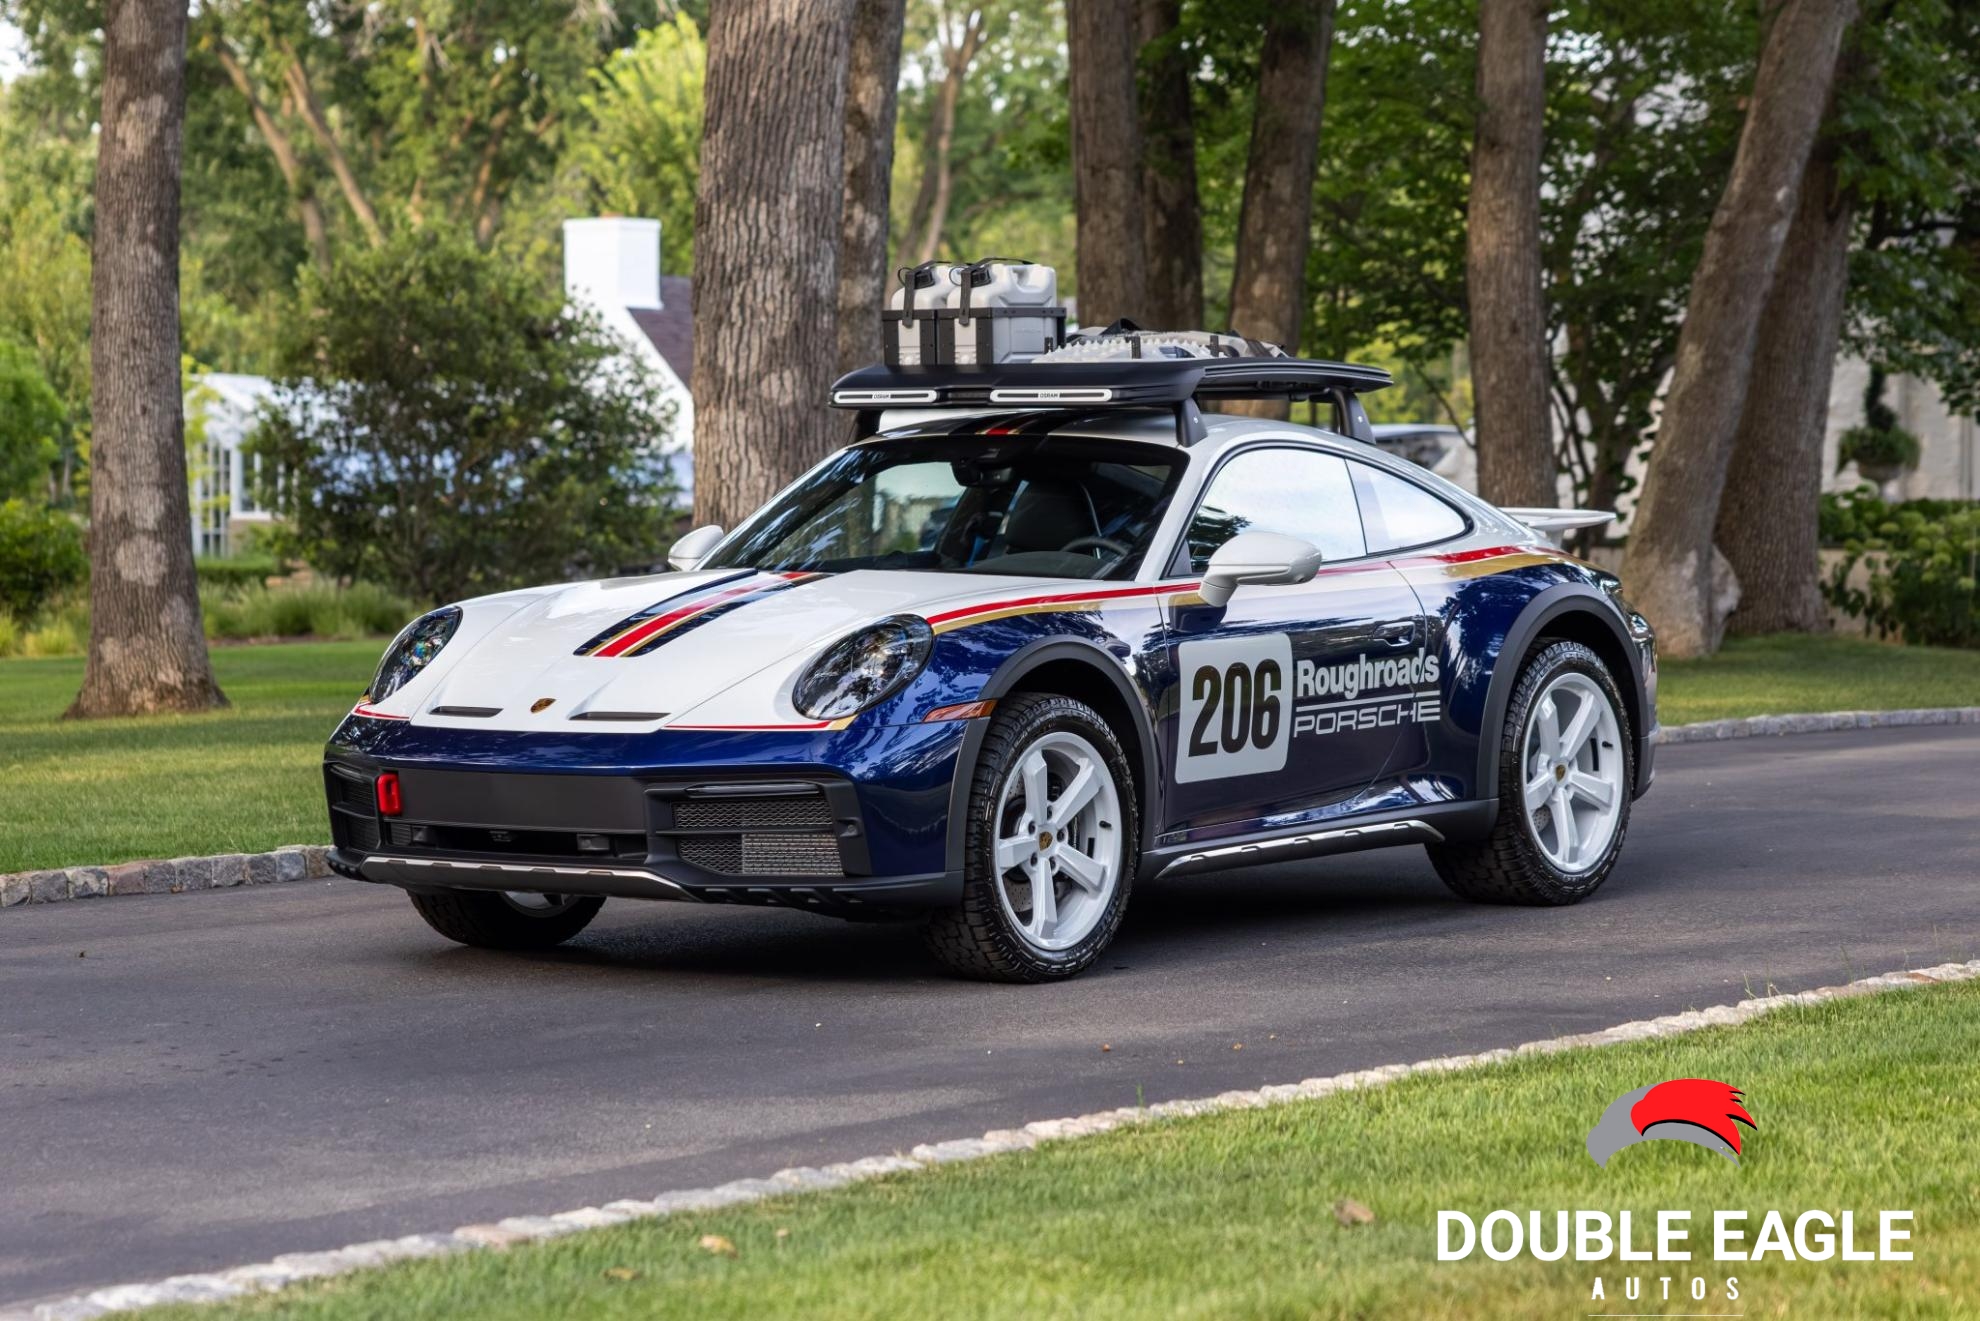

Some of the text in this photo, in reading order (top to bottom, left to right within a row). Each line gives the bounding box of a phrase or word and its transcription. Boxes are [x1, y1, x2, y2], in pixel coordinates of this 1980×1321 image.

[1297, 647, 1440, 700] Roughroads
[1188, 658, 1282, 758] 206
[1294, 700, 1440, 738] PORSCHE
